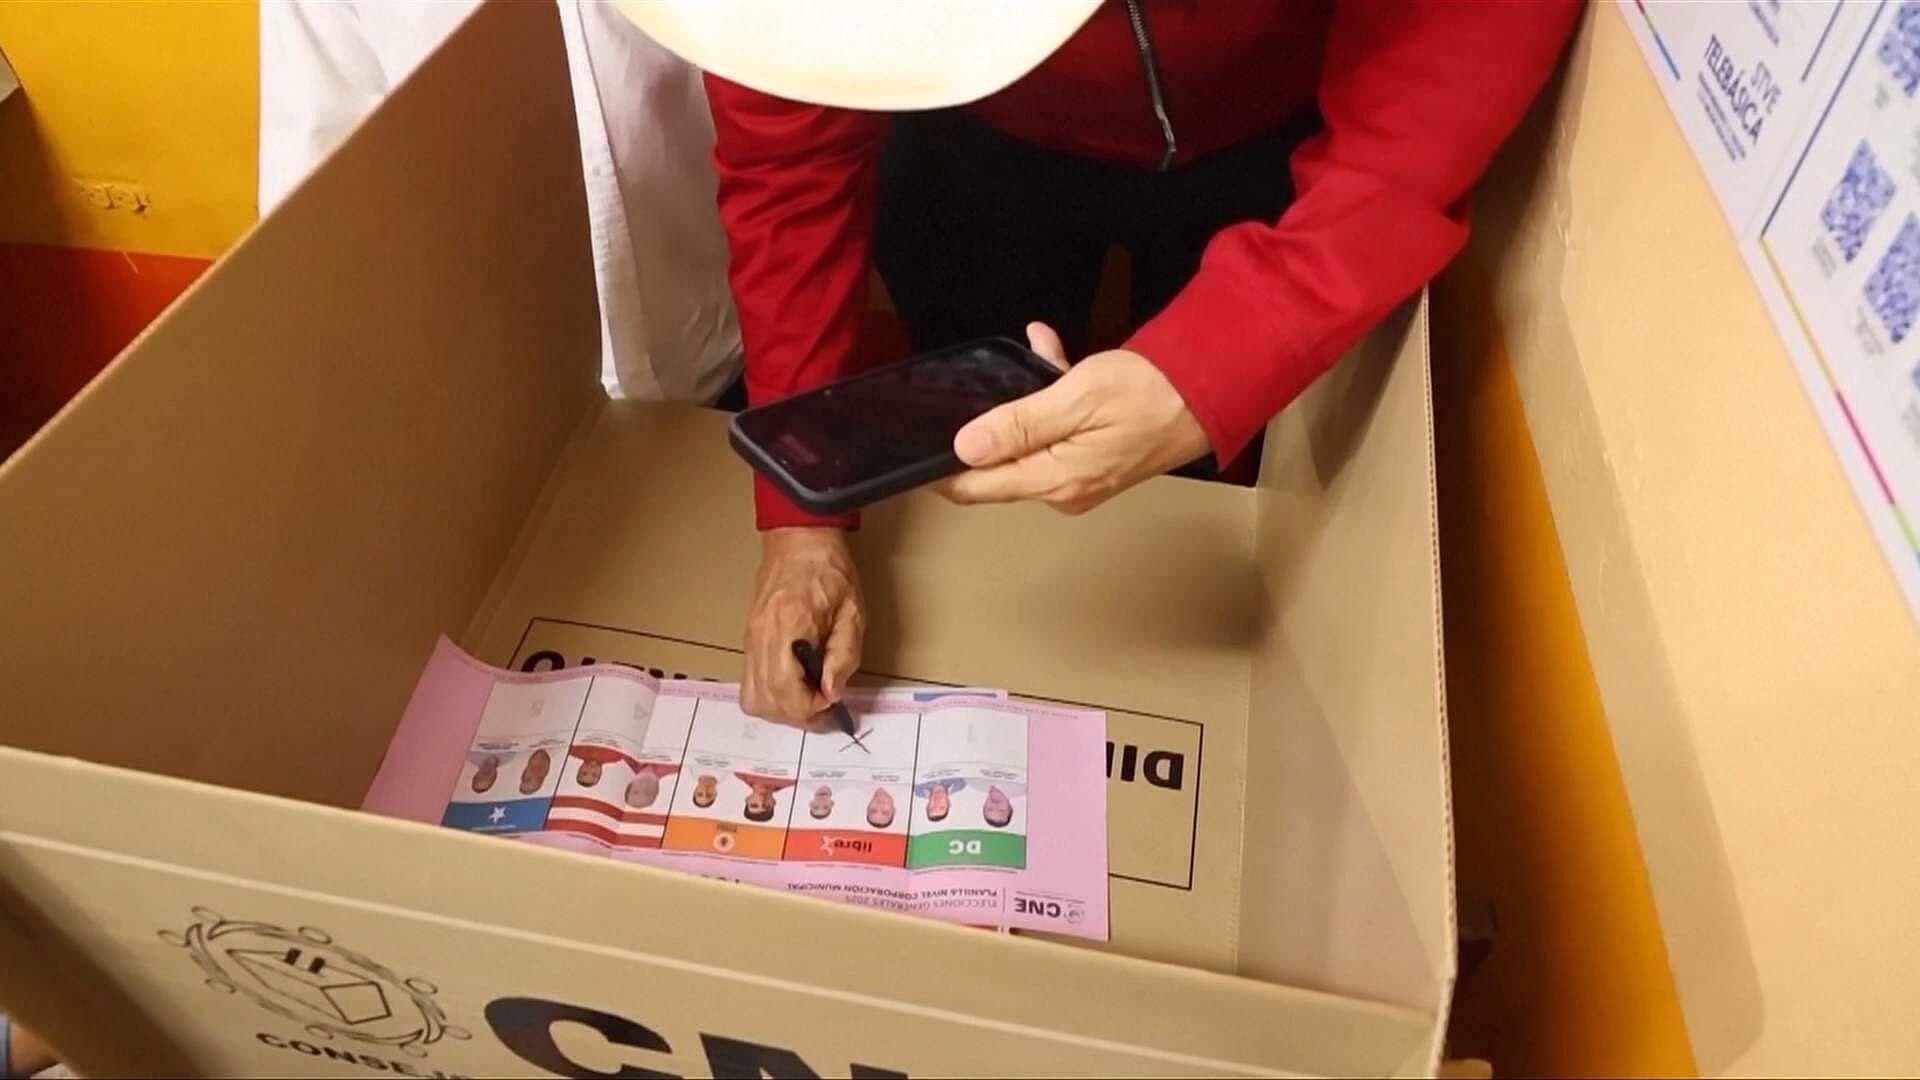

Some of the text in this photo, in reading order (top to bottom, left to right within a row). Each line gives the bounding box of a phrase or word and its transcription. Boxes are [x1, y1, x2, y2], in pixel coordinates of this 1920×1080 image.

[1704, 33, 1763, 147] TELEBÁSICA
[1106, 741, 1184, 791] DI
[834, 838, 873, 854] libre
[949, 839, 982, 855] DC
[787, 882, 841, 892] MUNICIPAL
[921, 889, 948, 899] NIVEL
[949, 888, 998, 897] PLANILLA
[872, 897, 930, 911] GENERALES
[934, 899, 998, 908] ELECCIONES
[1015, 897, 1061, 918] CNE
